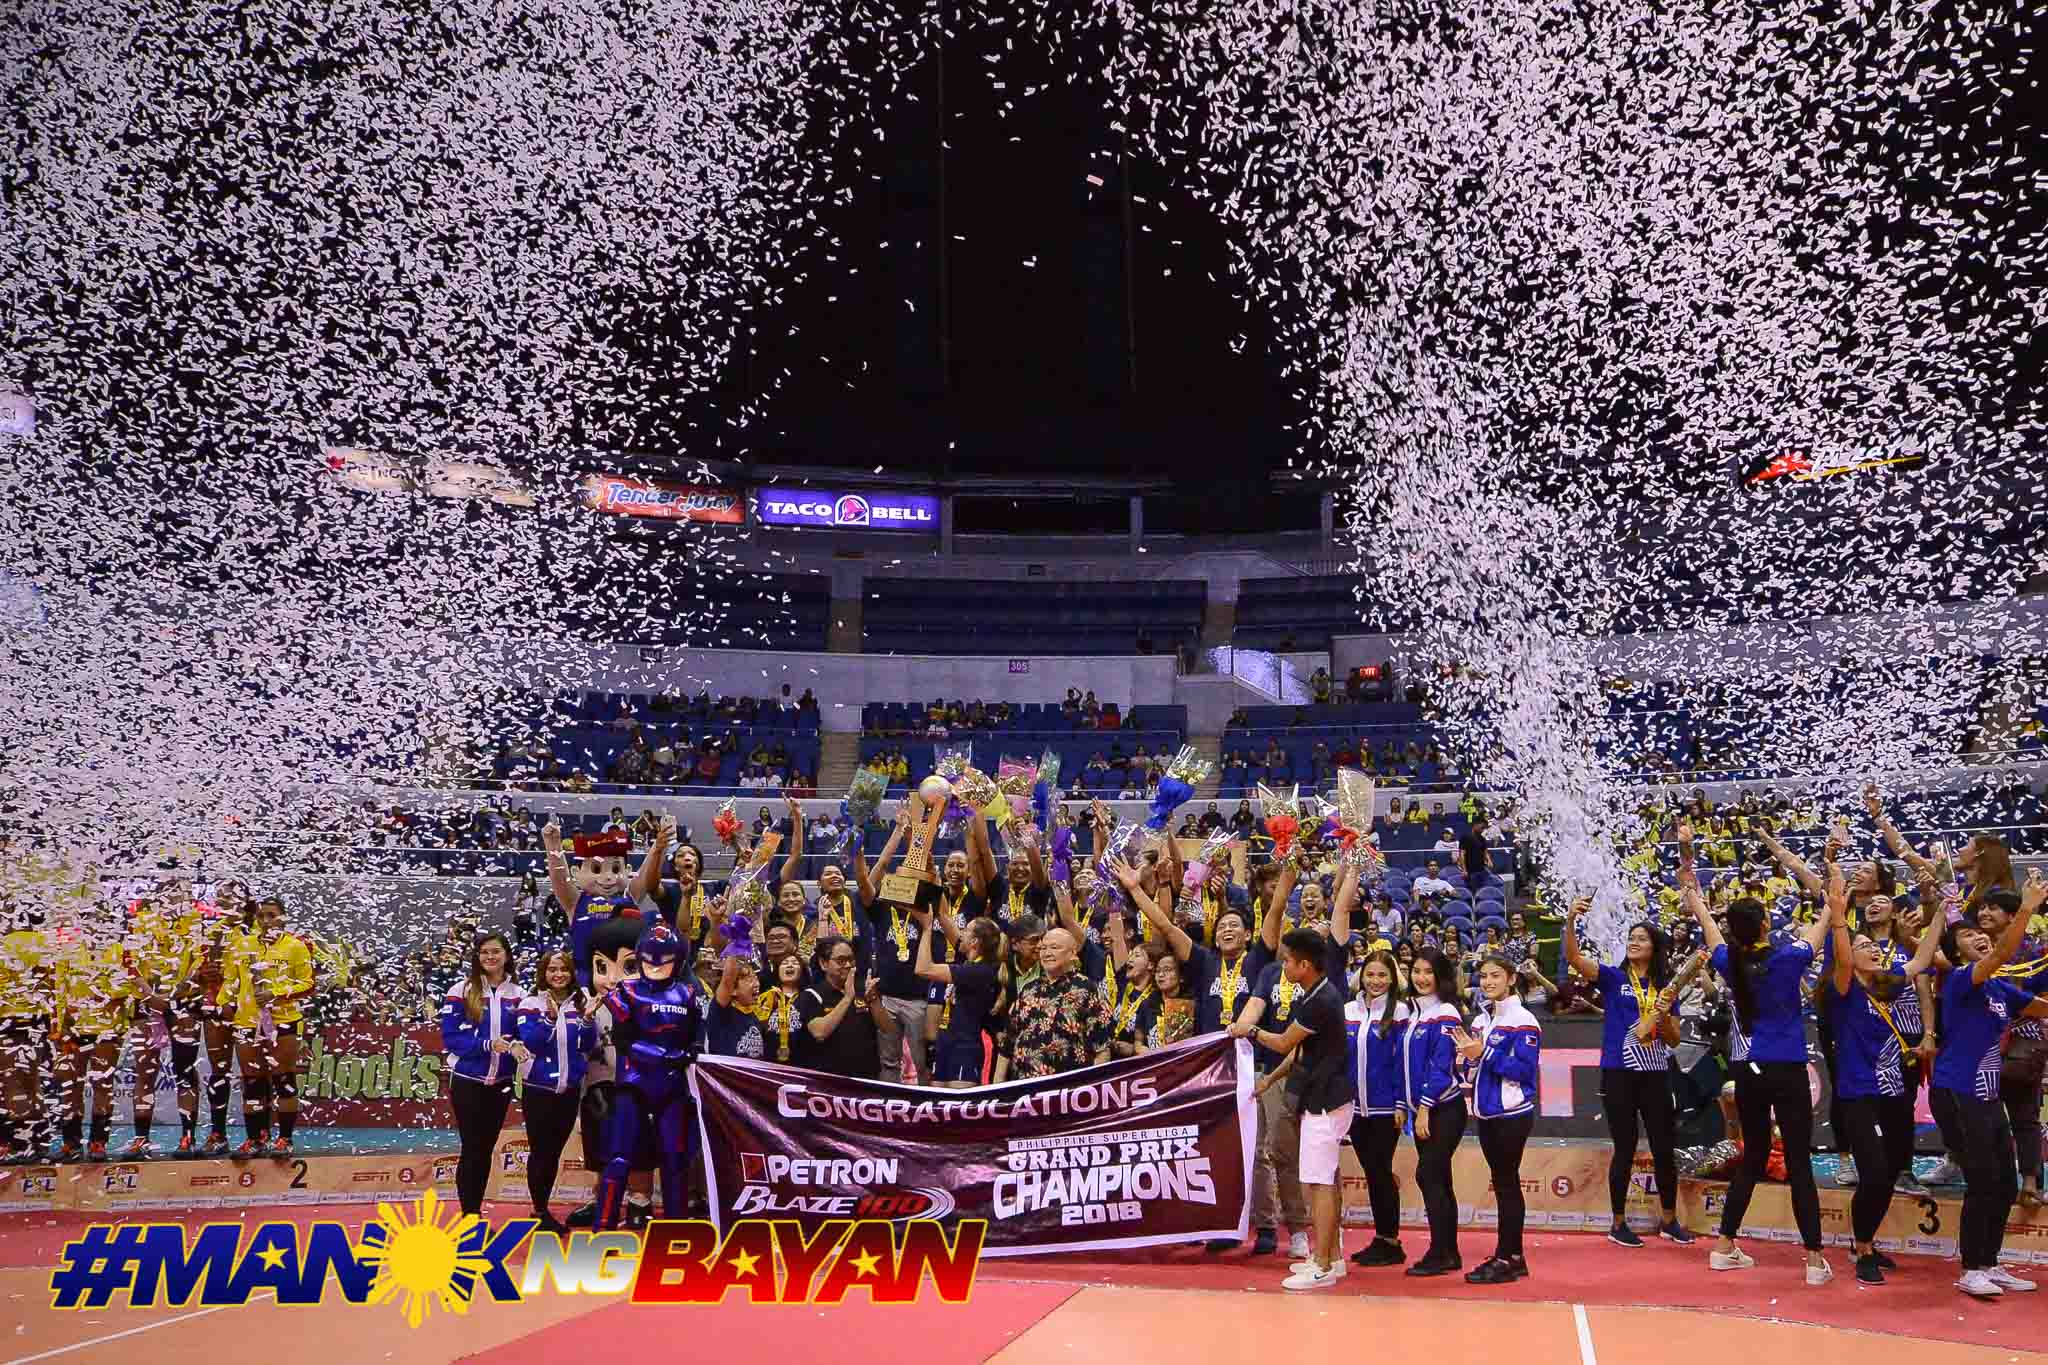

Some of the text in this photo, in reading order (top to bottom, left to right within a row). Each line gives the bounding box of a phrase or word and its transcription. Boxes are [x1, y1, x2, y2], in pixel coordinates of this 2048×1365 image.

[764, 502, 932, 521] TACO BELL
[1010, 661, 1028, 672] 305
[651, 1003, 688, 1016] PETRON
[777, 1076, 1159, 1123] CONGRATULATIONS
[1016, 1127, 1190, 1149] PHILIPPINE SUPER LIGA
[1008, 1137, 1201, 1172] GRAND PRIX
[289, 1159, 309, 1189] 2
[767, 1155, 899, 1185] PETRON
[731, 1185, 859, 1215] BLAZE
[992, 1157, 1217, 1220] CHAMPIONS
[1061, 1201, 1143, 1227] 2018
[1917, 1199, 1941, 1235] 3
